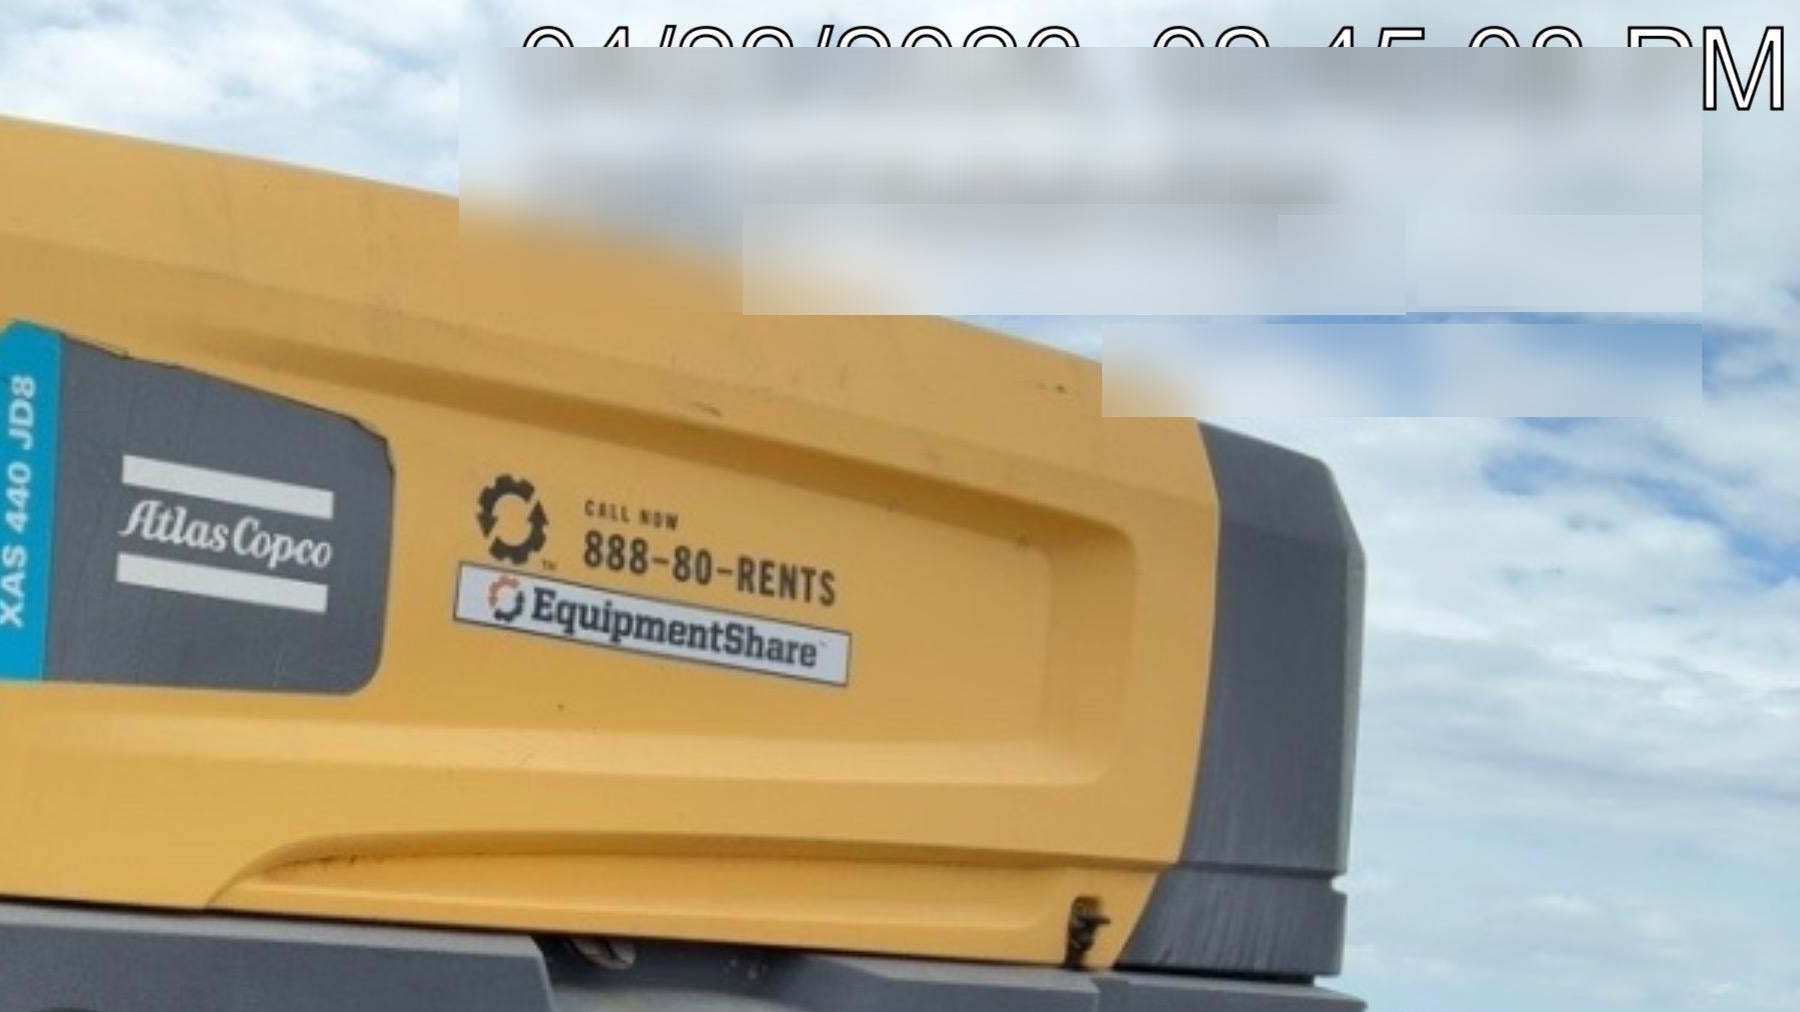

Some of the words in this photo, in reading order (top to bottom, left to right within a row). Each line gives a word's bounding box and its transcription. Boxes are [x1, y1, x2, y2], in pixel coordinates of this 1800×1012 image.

[8, 375, 36, 450] JD8
[5, 461, 32, 533] 440
[584, 499, 630, 524] CALL
[640, 508, 679, 531] NOW
[117, 500, 229, 553] Atlas
[232, 516, 333, 579] Copco
[583, 529, 836, 607] 888-80-RENTS
[531, 586, 818, 667] EquipmentShare
